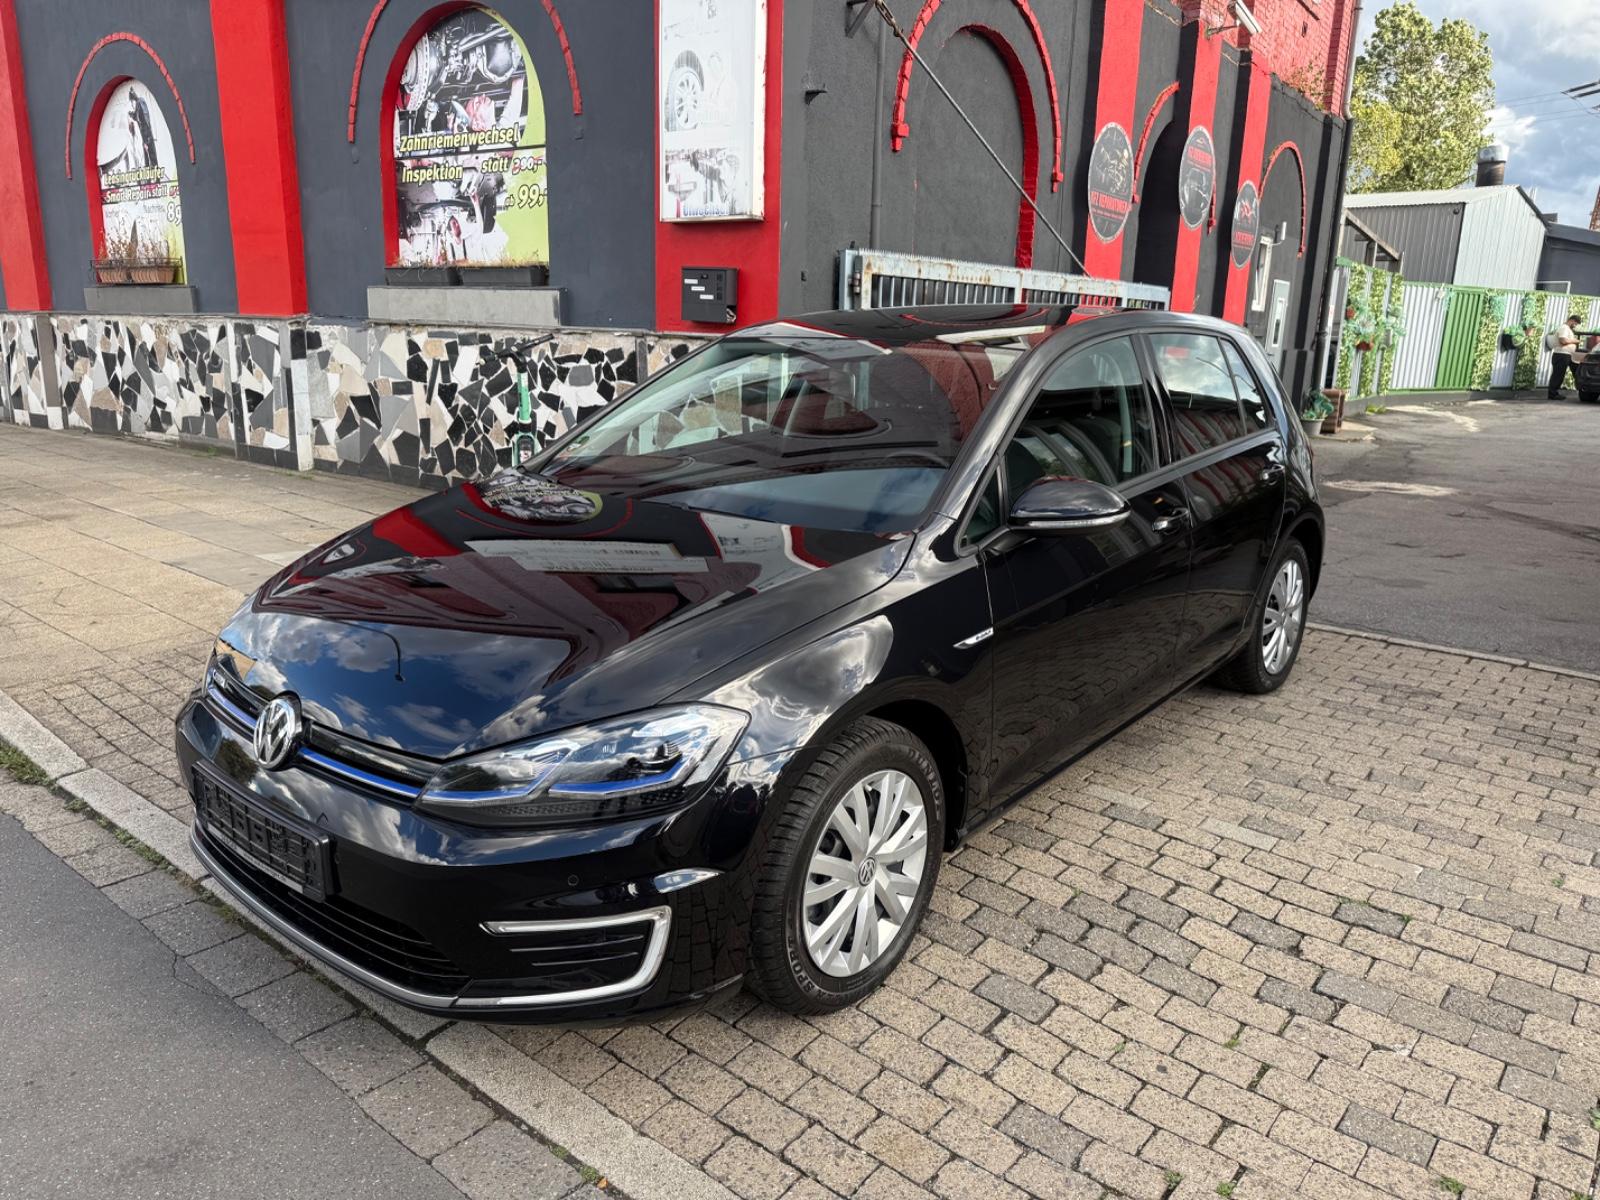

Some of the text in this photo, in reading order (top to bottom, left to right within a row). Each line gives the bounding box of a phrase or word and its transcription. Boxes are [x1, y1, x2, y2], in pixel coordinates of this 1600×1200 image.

[400, 123, 521, 152] Zahnriemenwechsel
[401, 161, 463, 186] Inspektion
[480, 156, 509, 174] statt
